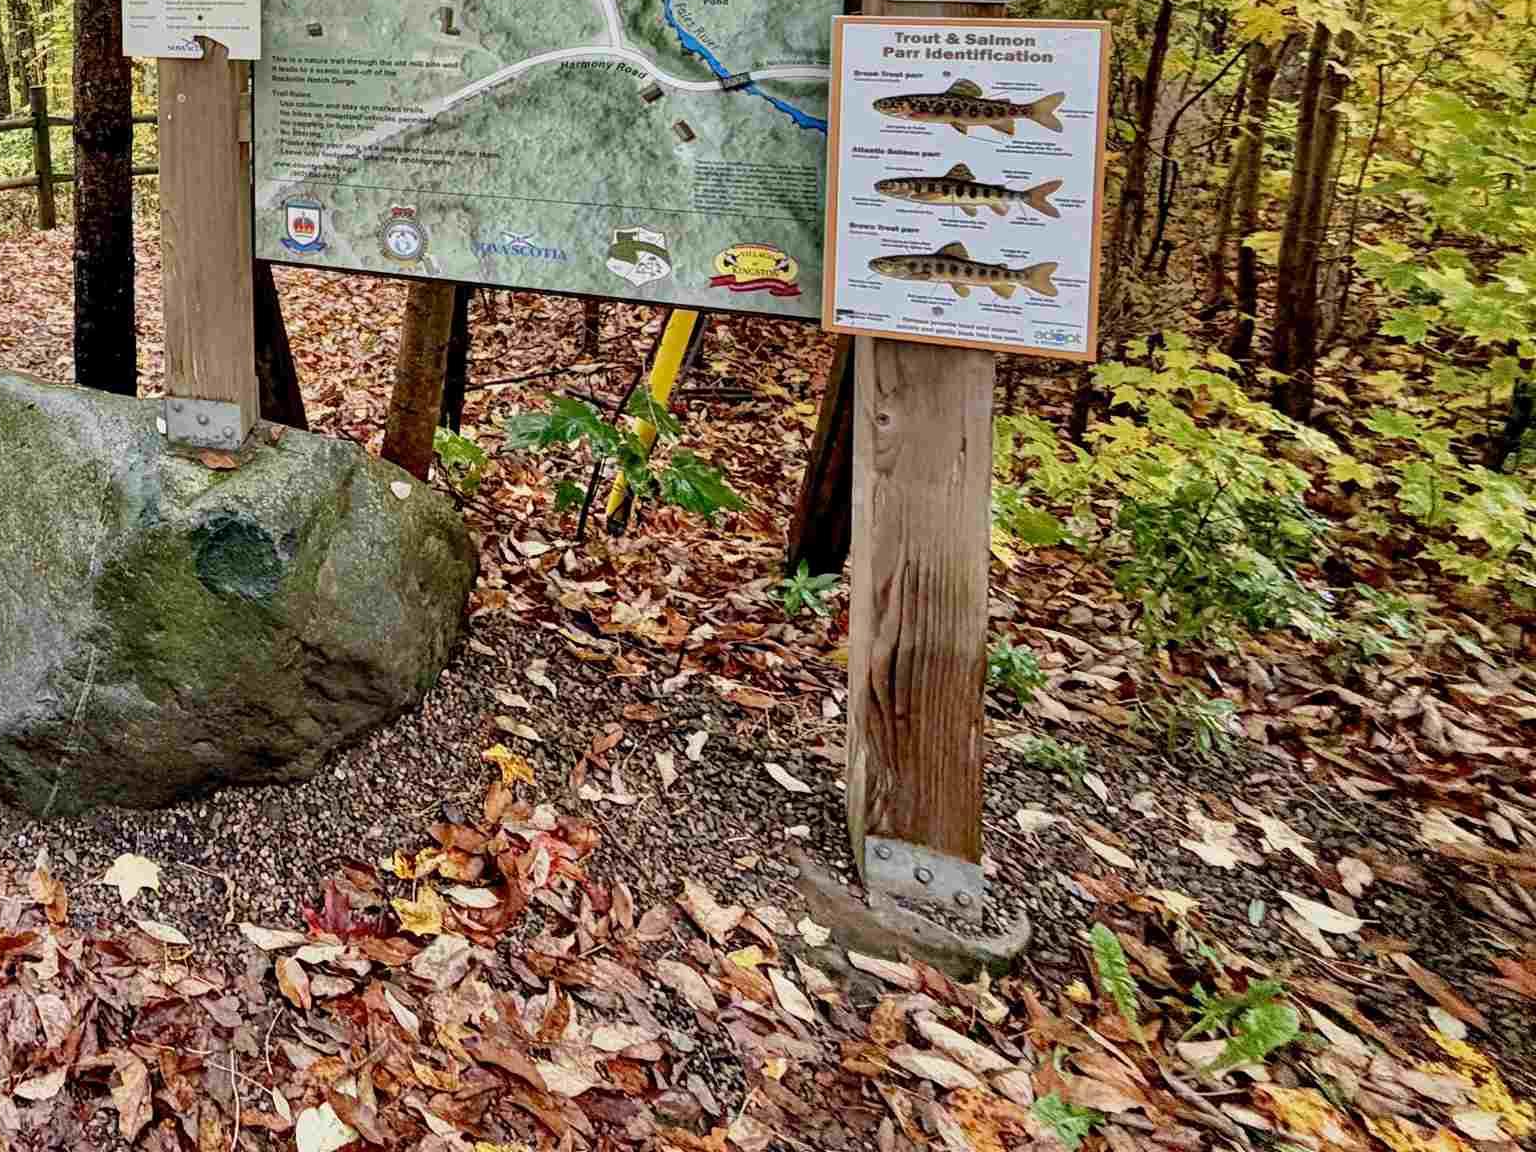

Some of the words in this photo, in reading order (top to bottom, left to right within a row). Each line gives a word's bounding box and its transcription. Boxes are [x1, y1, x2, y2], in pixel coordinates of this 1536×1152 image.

[894, 32, 941, 45] Trout
[945, 32, 960, 44] &
[964, 33, 1036, 47] Salmon
[882, 46, 919, 59] Parr
[925, 47, 1053, 64] Identification
[560, 60, 612, 72] Harmony
[615, 61, 649, 80] Road
